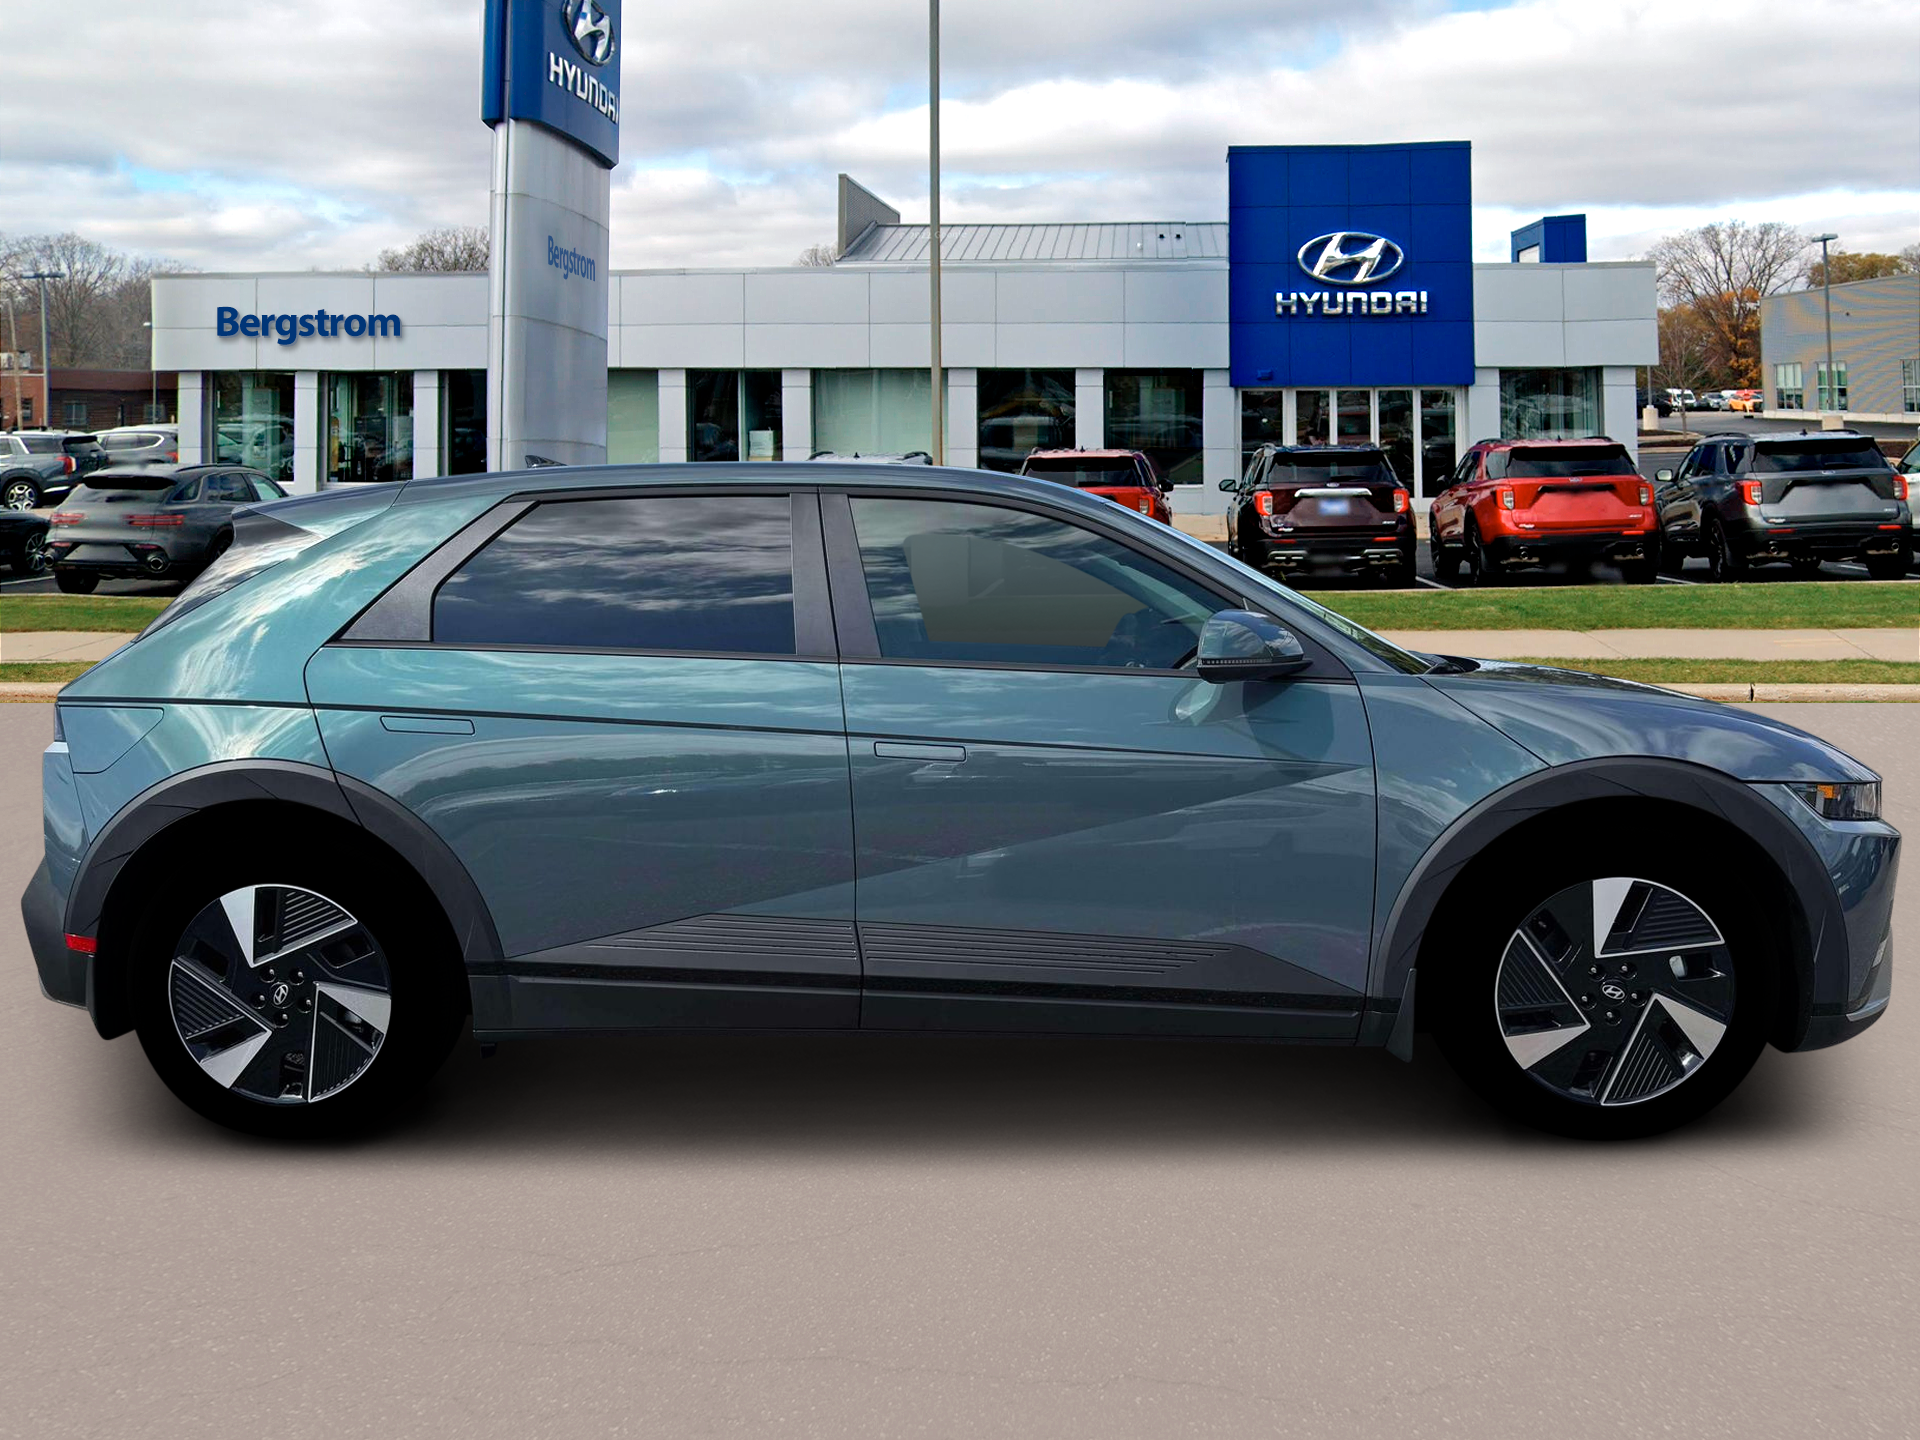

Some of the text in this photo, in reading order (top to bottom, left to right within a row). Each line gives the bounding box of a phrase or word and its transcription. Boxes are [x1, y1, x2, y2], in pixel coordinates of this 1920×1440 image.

[549, 52, 619, 124] HYUNDAI
[547, 235, 596, 282] Bergstrom
[1275, 291, 1428, 315] HYUNDAI
[216, 306, 401, 346] Bergstrom
